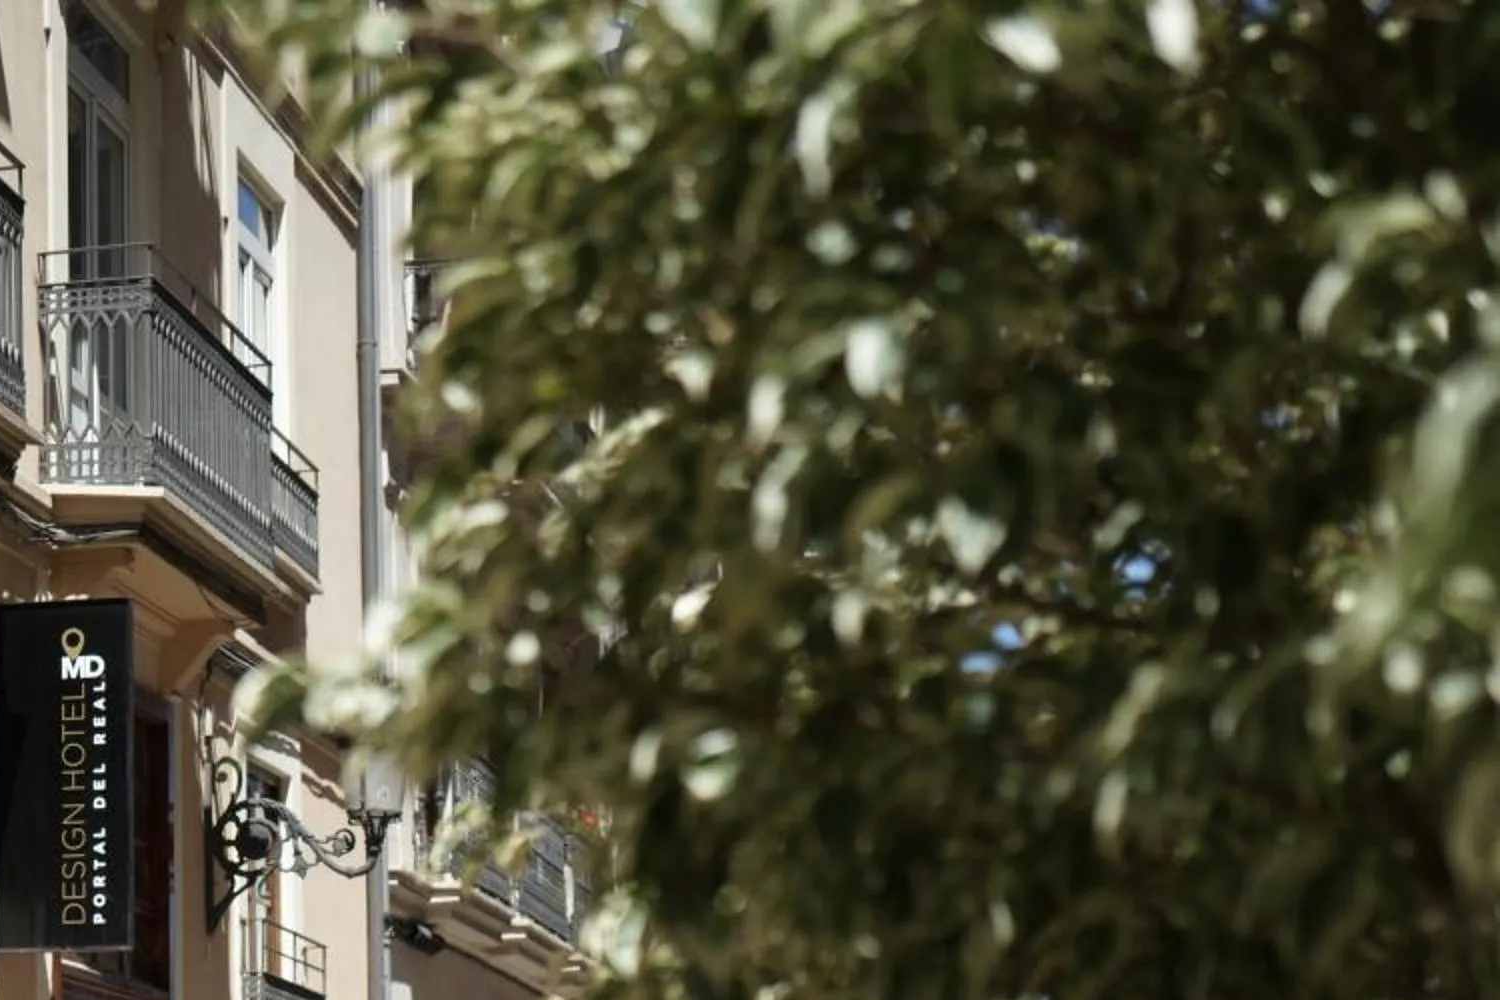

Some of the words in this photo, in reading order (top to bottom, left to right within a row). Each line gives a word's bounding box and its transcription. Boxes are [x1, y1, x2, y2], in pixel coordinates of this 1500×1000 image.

[61, 655, 105, 680] MD
[61, 681, 86, 791] HOTEL
[91, 680, 107, 746] REAL
[91, 762, 108, 810] DEL
[61, 803, 87, 925] DESIGN
[91, 826, 108, 926] PORTAL
